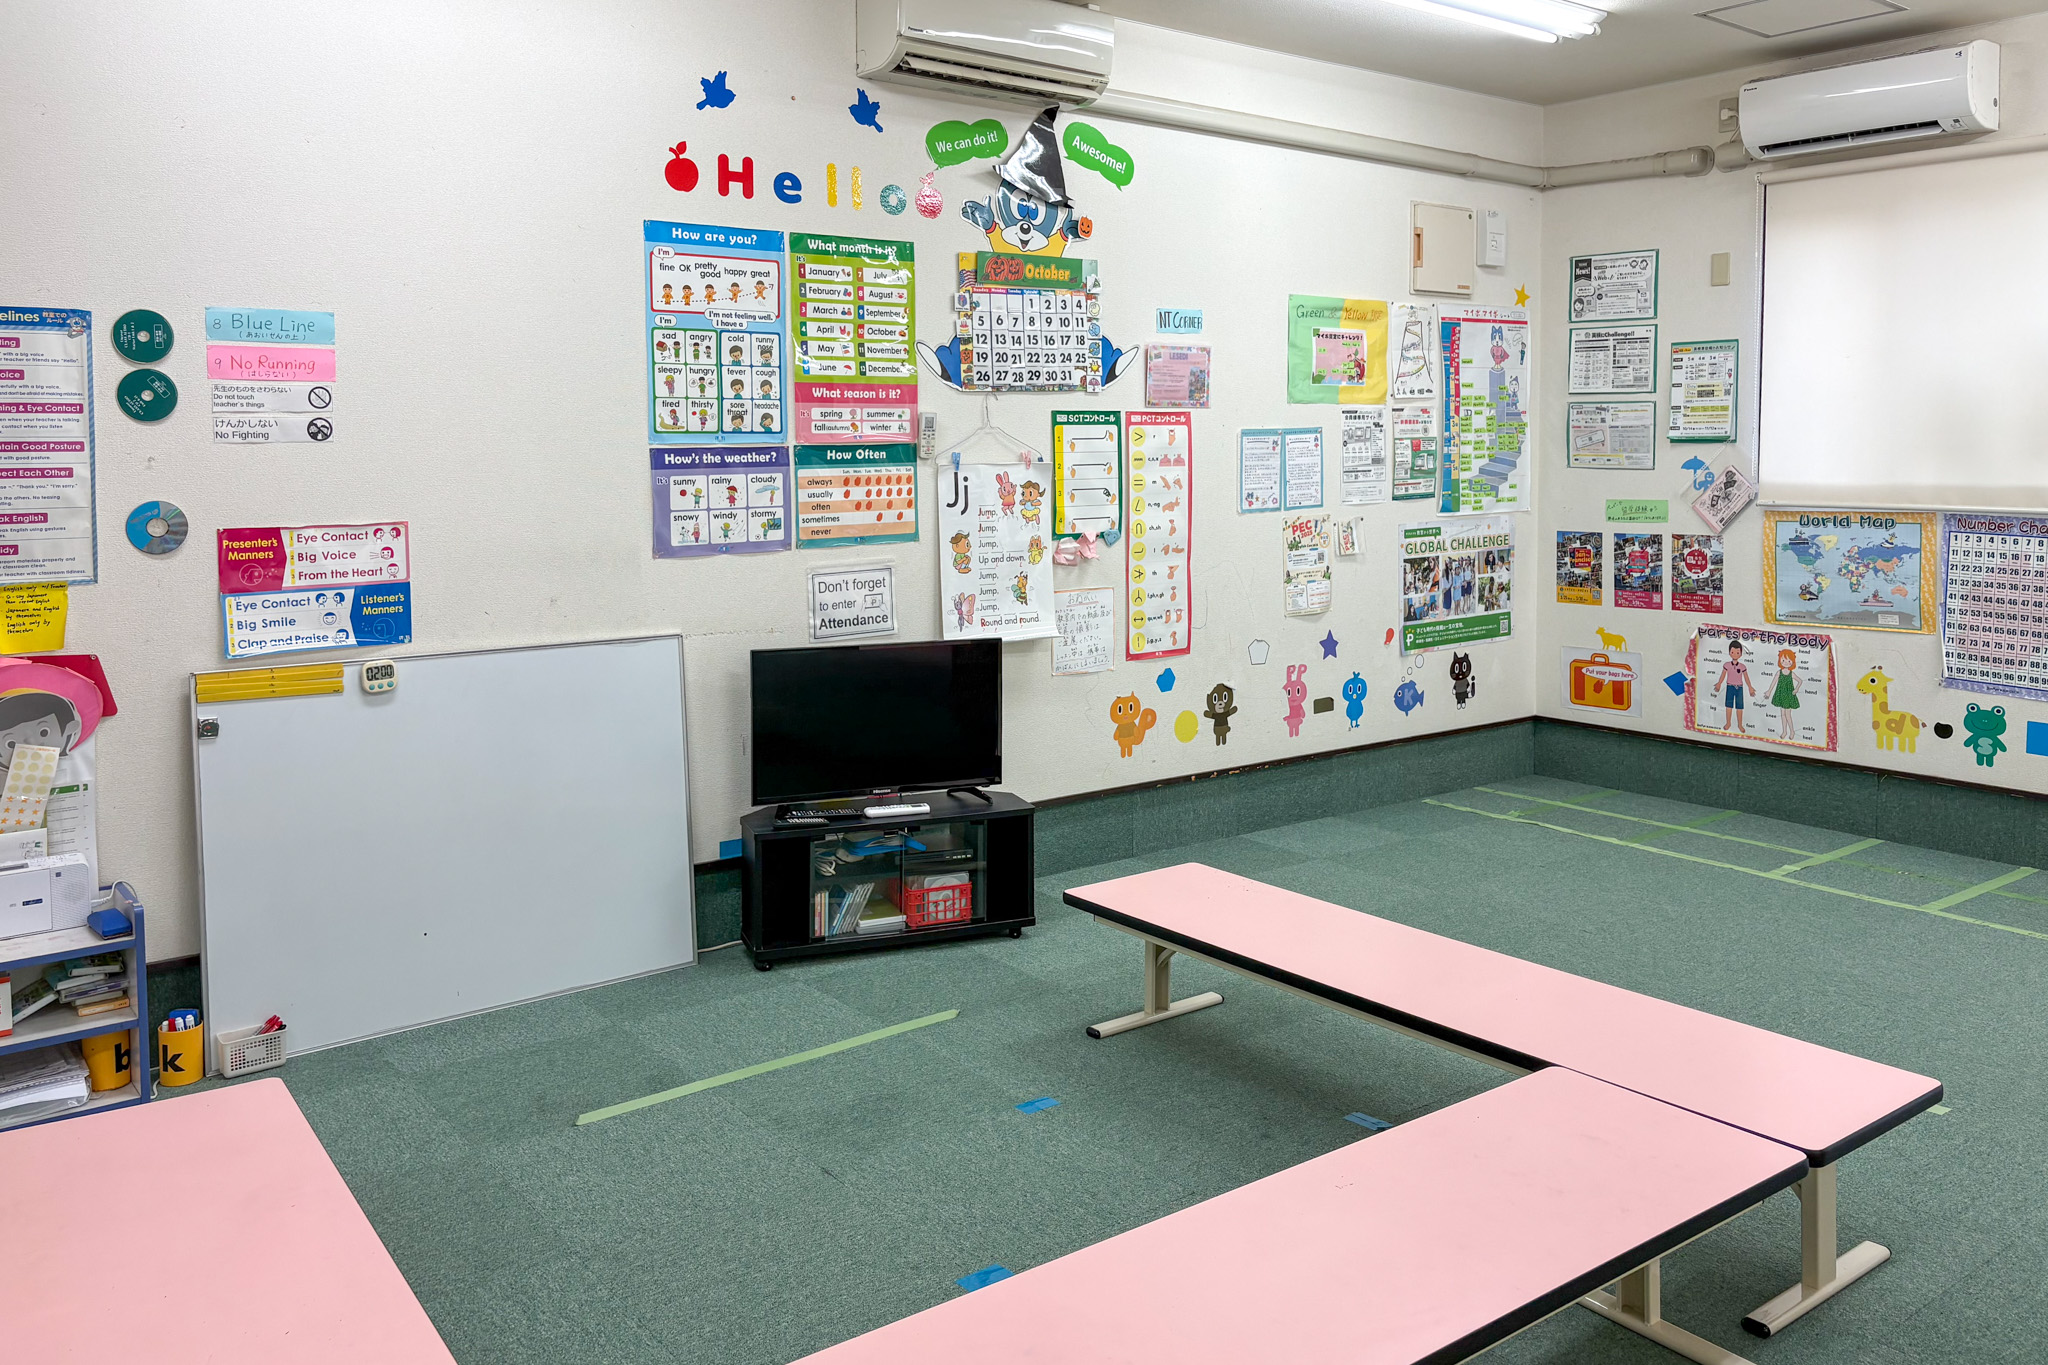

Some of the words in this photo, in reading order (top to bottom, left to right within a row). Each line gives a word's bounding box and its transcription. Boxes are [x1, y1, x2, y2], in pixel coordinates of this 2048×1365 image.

[936, 140, 952, 153] We
[954, 137, 972, 149] can
[974, 134, 986, 146] do
[987, 131, 998, 143] it!
[1072, 135, 1126, 174] Awesome!
[718, 154, 906, 215] Hello
[672, 228, 700, 240] How
[705, 233, 725, 241] are
[730, 235, 757, 245] you?
[659, 263, 675, 271] fine
[679, 264, 691, 272] OK
[695, 262, 717, 271] pretty
[700, 271, 721, 279] good
[724, 267, 747, 277] happy
[751, 270, 770, 278] great
[808, 268, 840, 278] January
[1025, 264, 1070, 280] October
[809, 287, 841, 296] February
[869, 291, 893, 299] August
[813, 306, 837, 314] March
[1296, 305, 1324, 319] Green
[1344, 308, 1367, 320] Yellow
[213, 319, 221, 329] 8
[232, 313, 272, 330] Blue
[280, 316, 315, 332] Line
[1159, 312, 1172, 328] NT
[816, 326, 834, 334] April
[867, 328, 896, 336] October
[867, 346, 902, 355] November
[214, 358, 221, 369] 9
[231, 355, 252, 370] No
[258, 355, 315, 374] Running
[658, 366, 682, 375] sleepy
[689, 368, 715, 376] hungry
[976, 371, 990, 381] 26
[995, 371, 1009, 381] 27
[1012, 372, 1024, 382] 28
[1027, 371, 1041, 381] 29
[1045, 371, 1057, 381] 30
[1060, 371, 1072, 381] 31
[812, 388, 840, 398] What
[844, 390, 876, 398] season
[879, 390, 886, 398] is
[889, 390, 901, 398] it?
[27, 405, 42, 413] Eye
[45, 404, 80, 412] Contact
[820, 410, 842, 419] spring
[215, 420, 278, 428] けんかしない
[232, 432, 269, 440] Fighting
[22, 443, 47, 451] Good
[50, 443, 81, 451] Posture
[664, 453, 699, 464] How's
[703, 453, 721, 463] the
[724, 452, 776, 463] weather?
[827, 450, 852, 460] How
[856, 449, 886, 459] Often
[20, 469, 40, 477] Each
[42, 469, 69, 477] Other
[712, 477, 732, 485] rainy
[751, 476, 777, 484] cloudy
[807, 491, 833, 499] usually
[13, 514, 44, 523] English
[674, 514, 699, 522] snowy
[1799, 514, 1851, 528] World
[1859, 516, 1897, 530] Map
[1292, 520, 1312, 535] PEC
[1957, 518, 2014, 531] Number
[296, 534, 318, 545] Eye
[321, 531, 368, 542] Contact
[1301, 530, 1313, 538] 2025
[223, 538, 278, 548] Presenter's
[1406, 541, 1448, 554] GLOBAL
[1451, 534, 1508, 550] CHALLENGE
[228, 551, 274, 561] Manners
[297, 552, 317, 563] Big
[322, 551, 356, 560] Voice
[979, 555, 989, 565] Up
[991, 555, 1004, 563] and
[1006, 554, 1026, 562] down.
[298, 571, 327, 581] From
[330, 569, 349, 578] the
[352, 567, 383, 577] Heart
[818, 580, 849, 593] Don't
[853, 577, 886, 591] forget
[236, 601, 257, 611] Eye
[261, 597, 310, 609] Contact
[360, 594, 404, 604] Listener's
[362, 606, 403, 615] Manners
[819, 602, 828, 611] to
[832, 600, 856, 610] enter
[236, 620, 257, 631] Big
[261, 617, 296, 627] Smile
[819, 614, 888, 630] Attendance
[981, 617, 1002, 627] Round
[1005, 616, 1017, 625] and
[238, 639, 268, 650] Clap
[270, 636, 292, 646] and
[295, 633, 329, 644] Praise
[1759, 633, 1785, 644] the
[1788, 634, 1829, 651] Body
[162, 1044, 185, 1072] k
